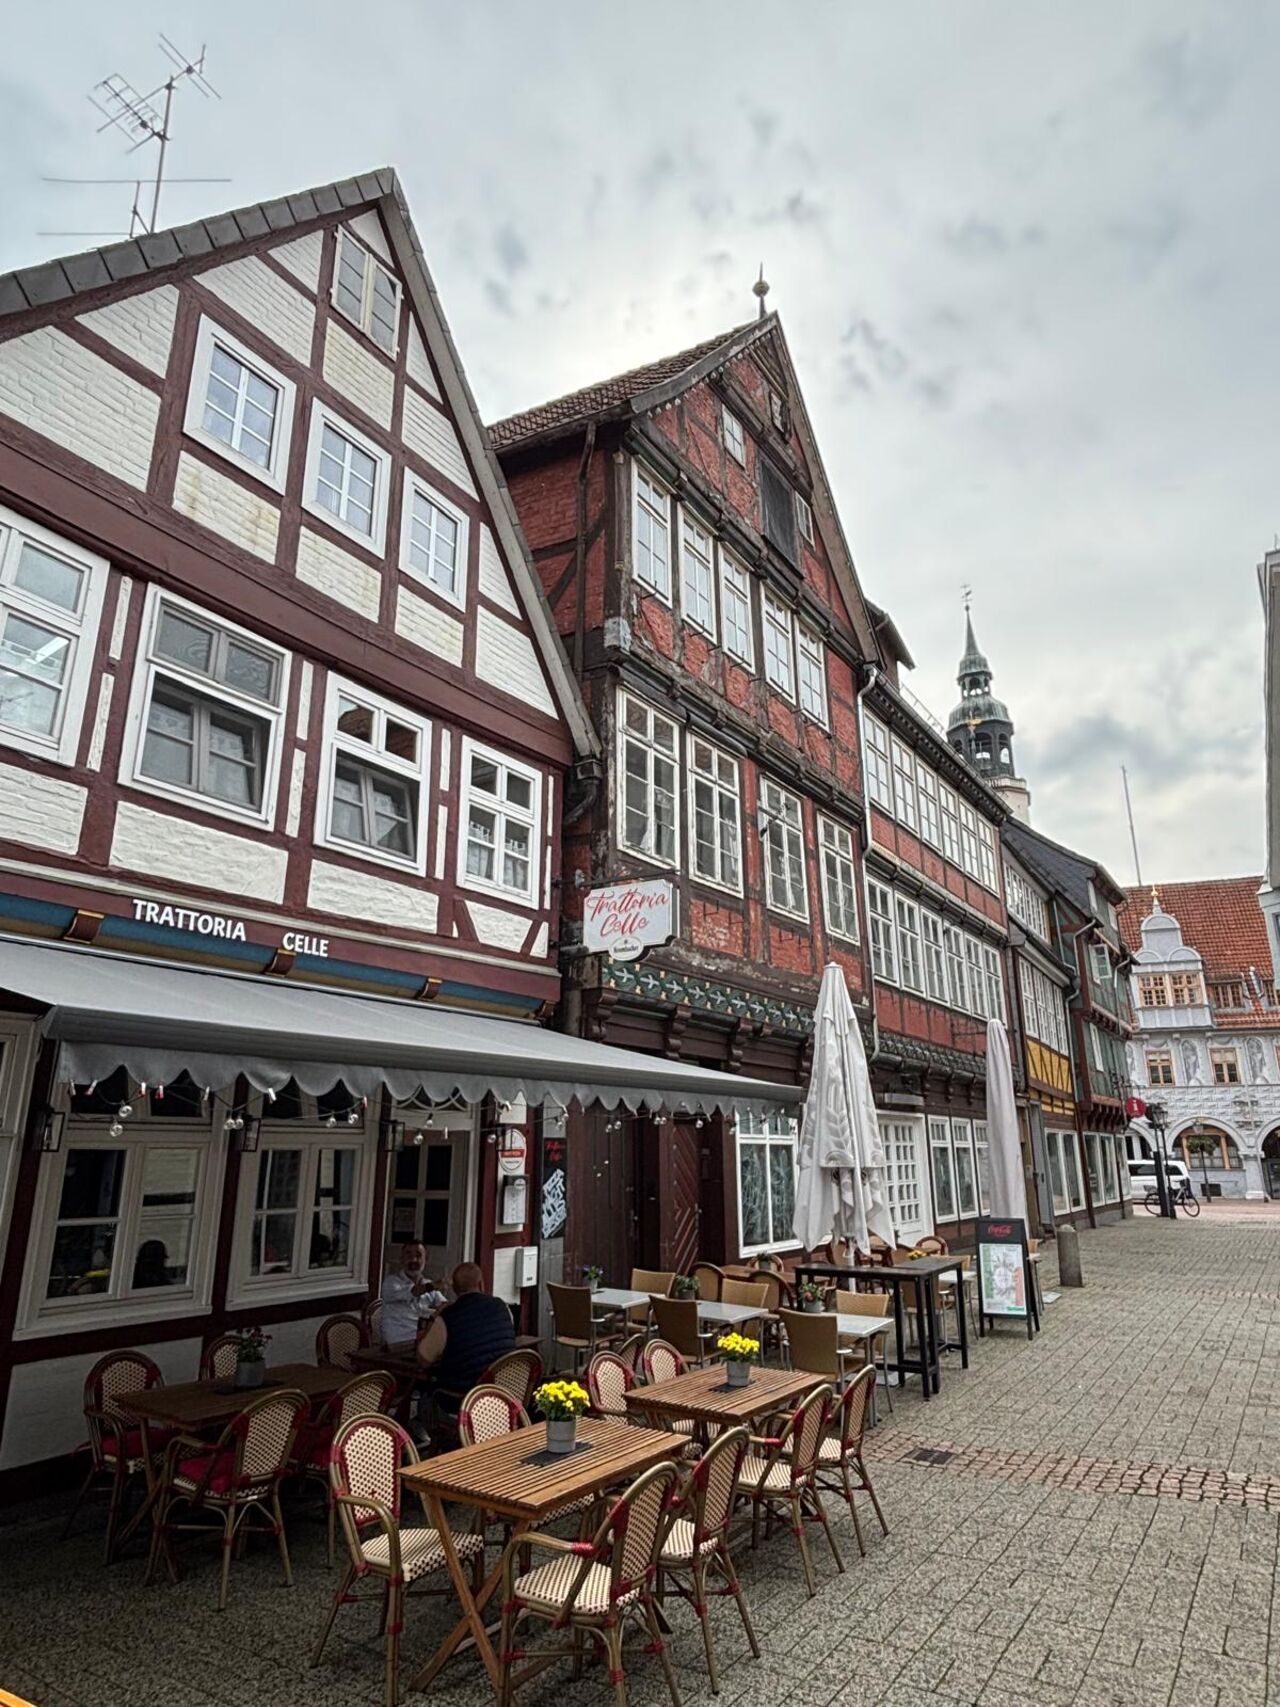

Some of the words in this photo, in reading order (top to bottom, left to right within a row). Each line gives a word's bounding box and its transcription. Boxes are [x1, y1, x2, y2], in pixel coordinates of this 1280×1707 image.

[587, 888, 668, 922] Trattoria
[133, 899, 246, 942] TRATTORIA
[282, 932, 329, 957] CELLE
[600, 912, 649, 937] Celle
